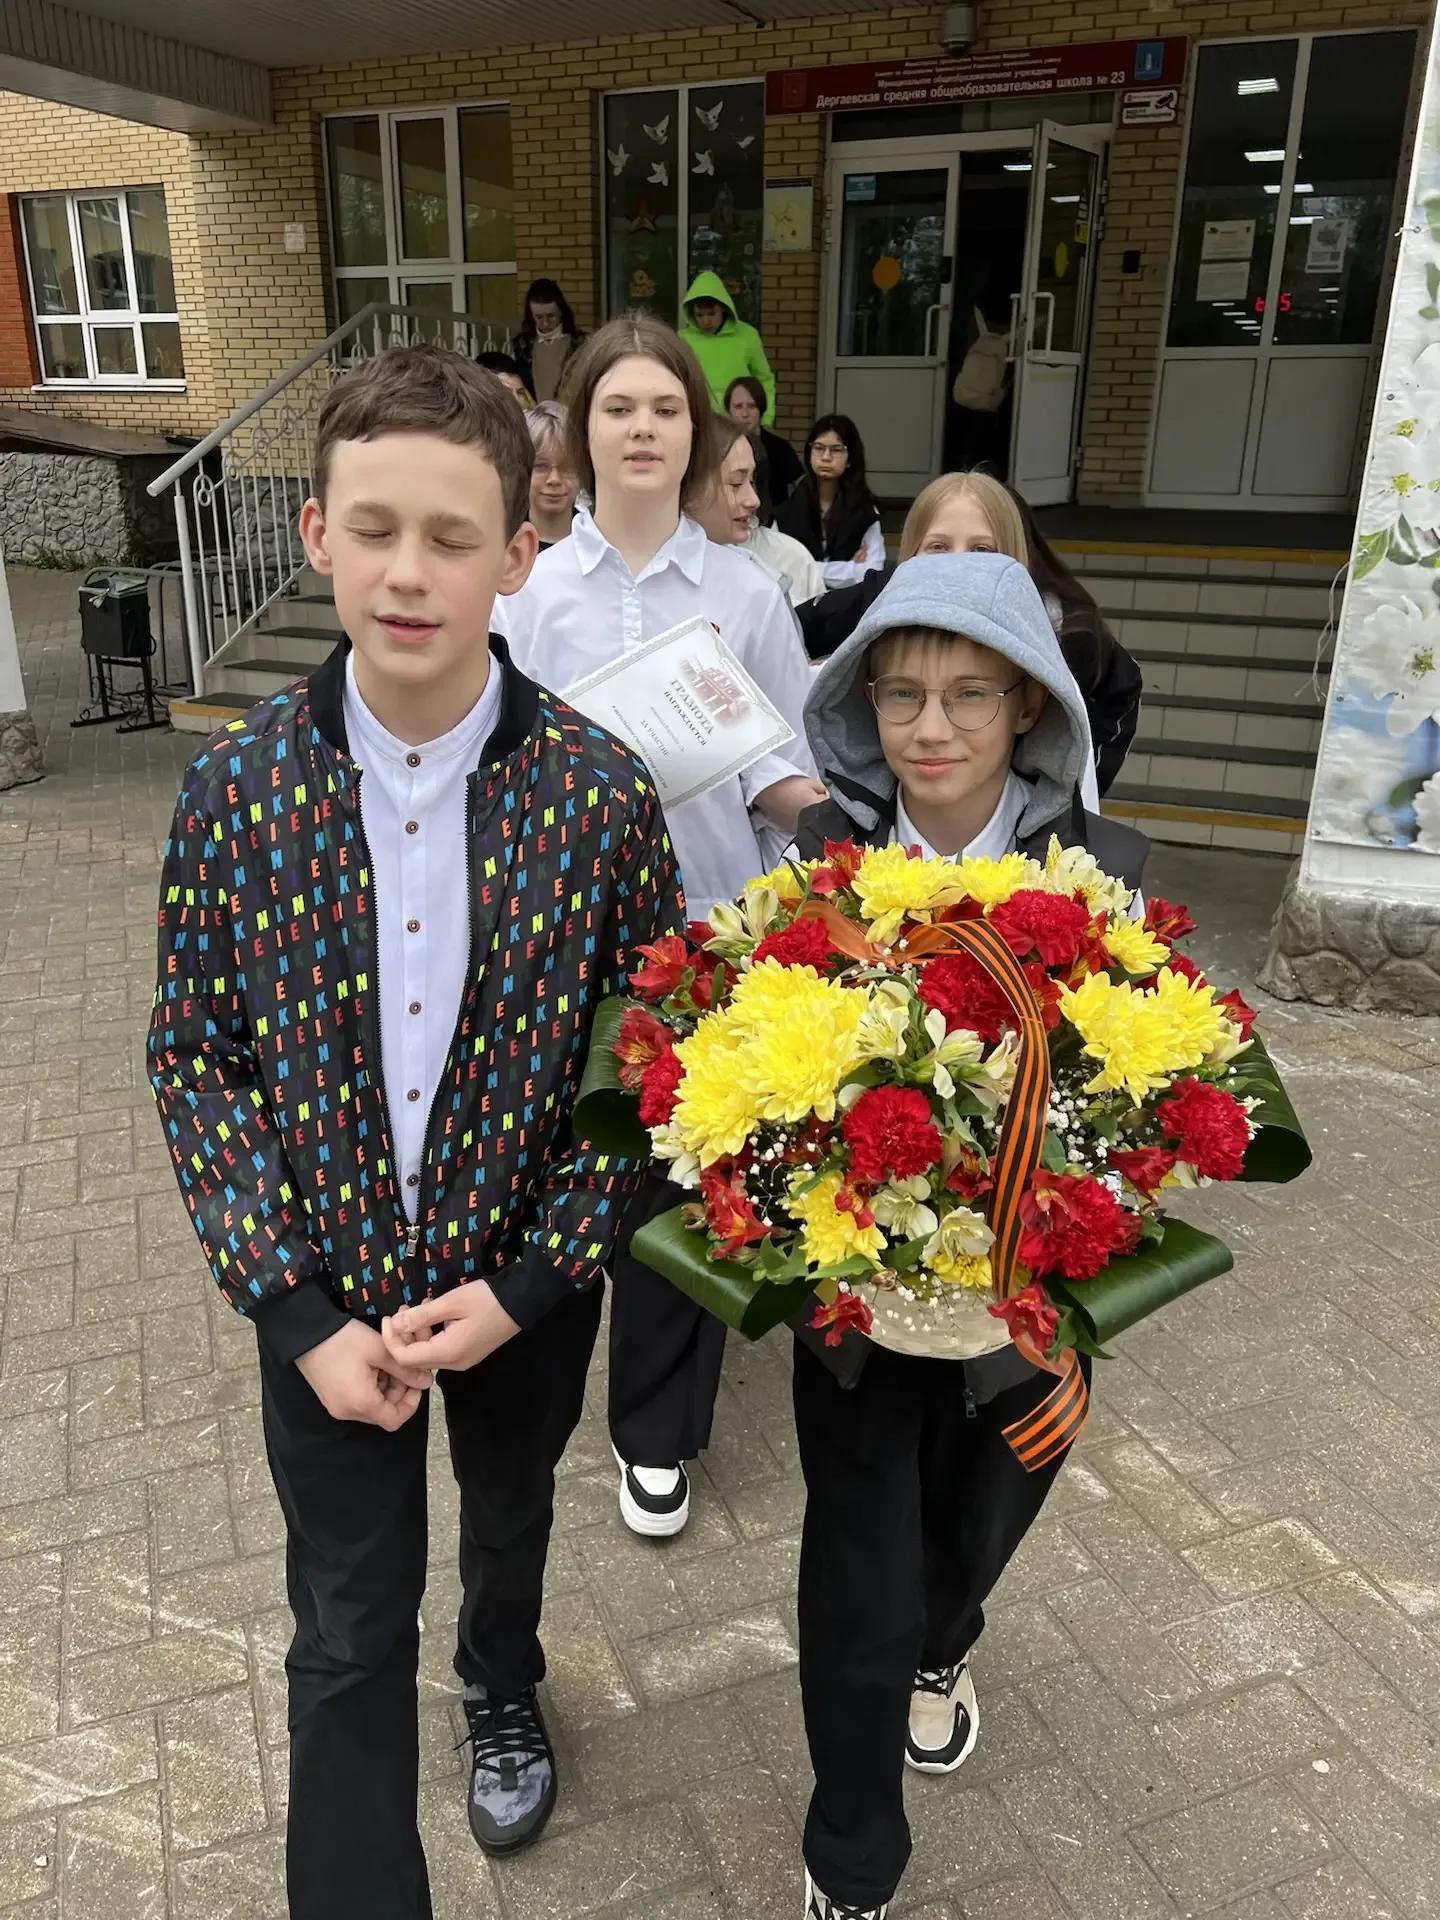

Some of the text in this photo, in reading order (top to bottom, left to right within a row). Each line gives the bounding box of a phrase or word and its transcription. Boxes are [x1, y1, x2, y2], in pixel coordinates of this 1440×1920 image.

[815, 70, 1126, 109] Дергаевская средняя общеобразовательная школа № 23
[663, 690, 707, 746] НАГРАЖДАЕТСЯ
[669, 679, 715, 736] ГРАМОТА
